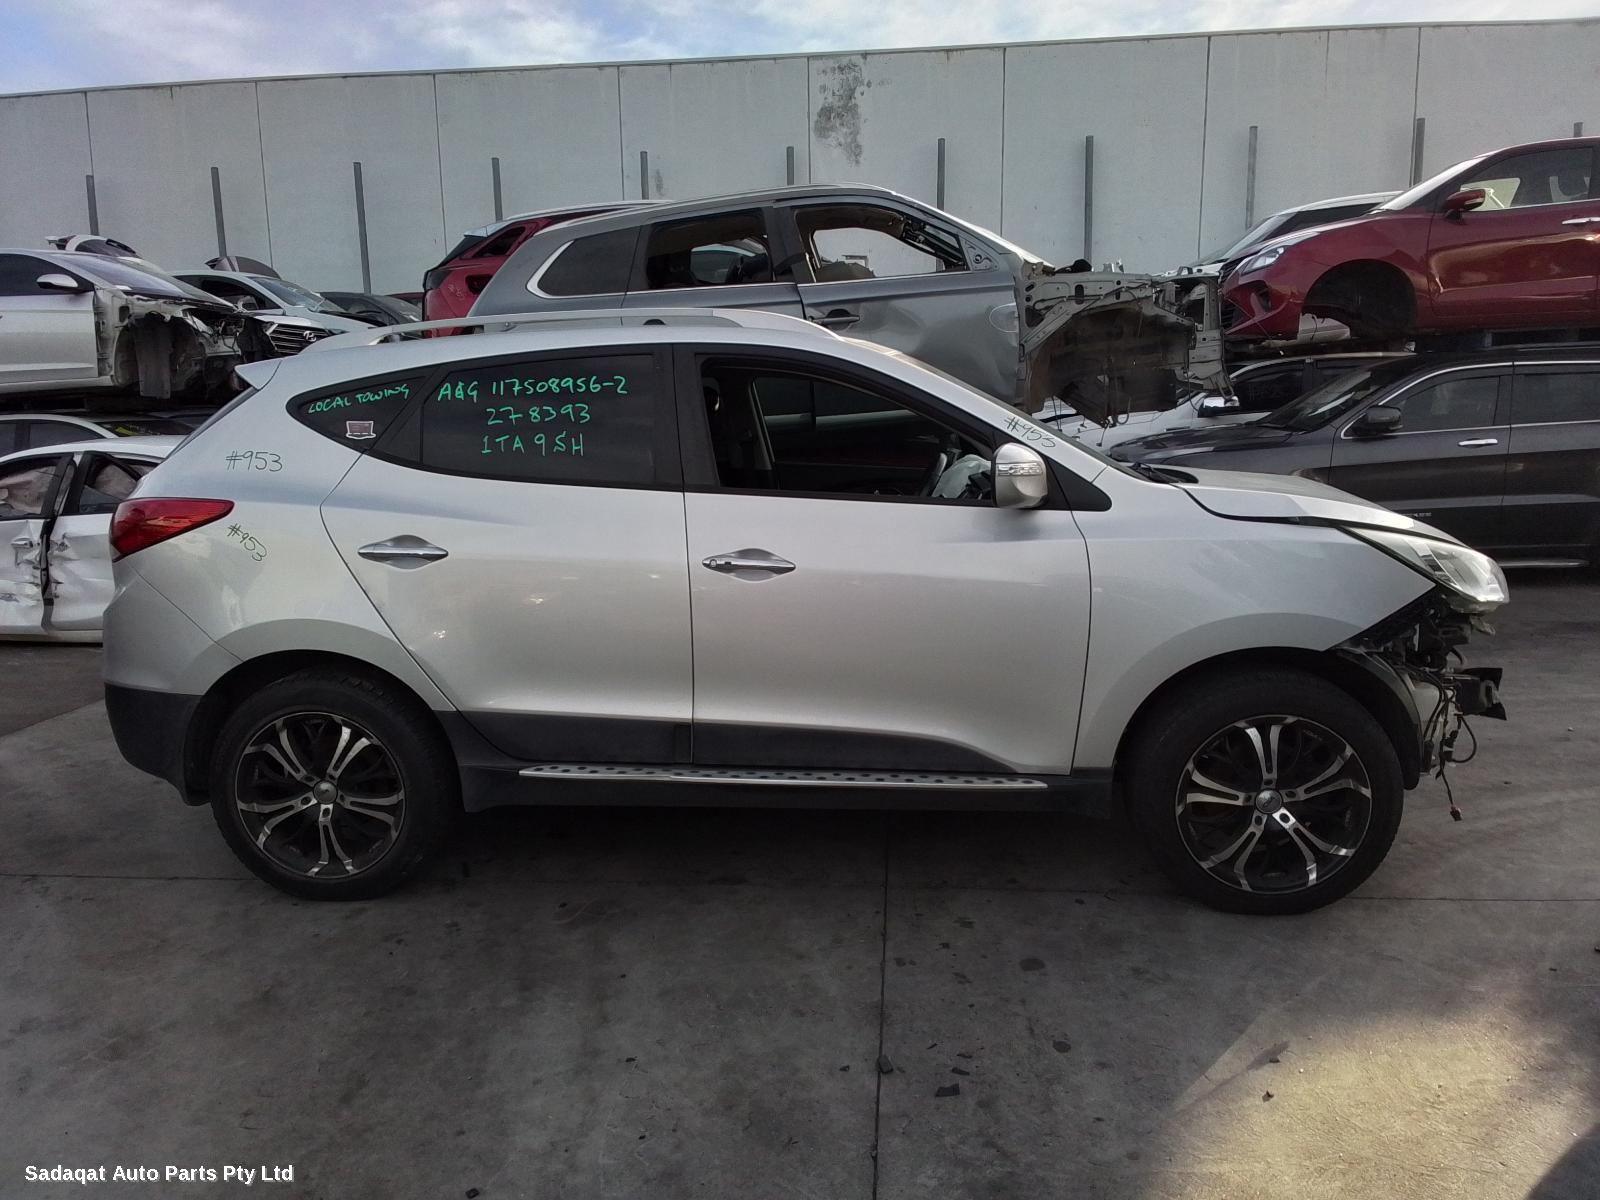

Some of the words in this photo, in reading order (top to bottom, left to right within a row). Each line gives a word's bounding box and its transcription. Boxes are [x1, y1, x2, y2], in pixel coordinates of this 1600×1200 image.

[1004, 416, 1056, 448] #953
[225, 450, 283, 472] #953
[227, 523, 267, 562] #953
